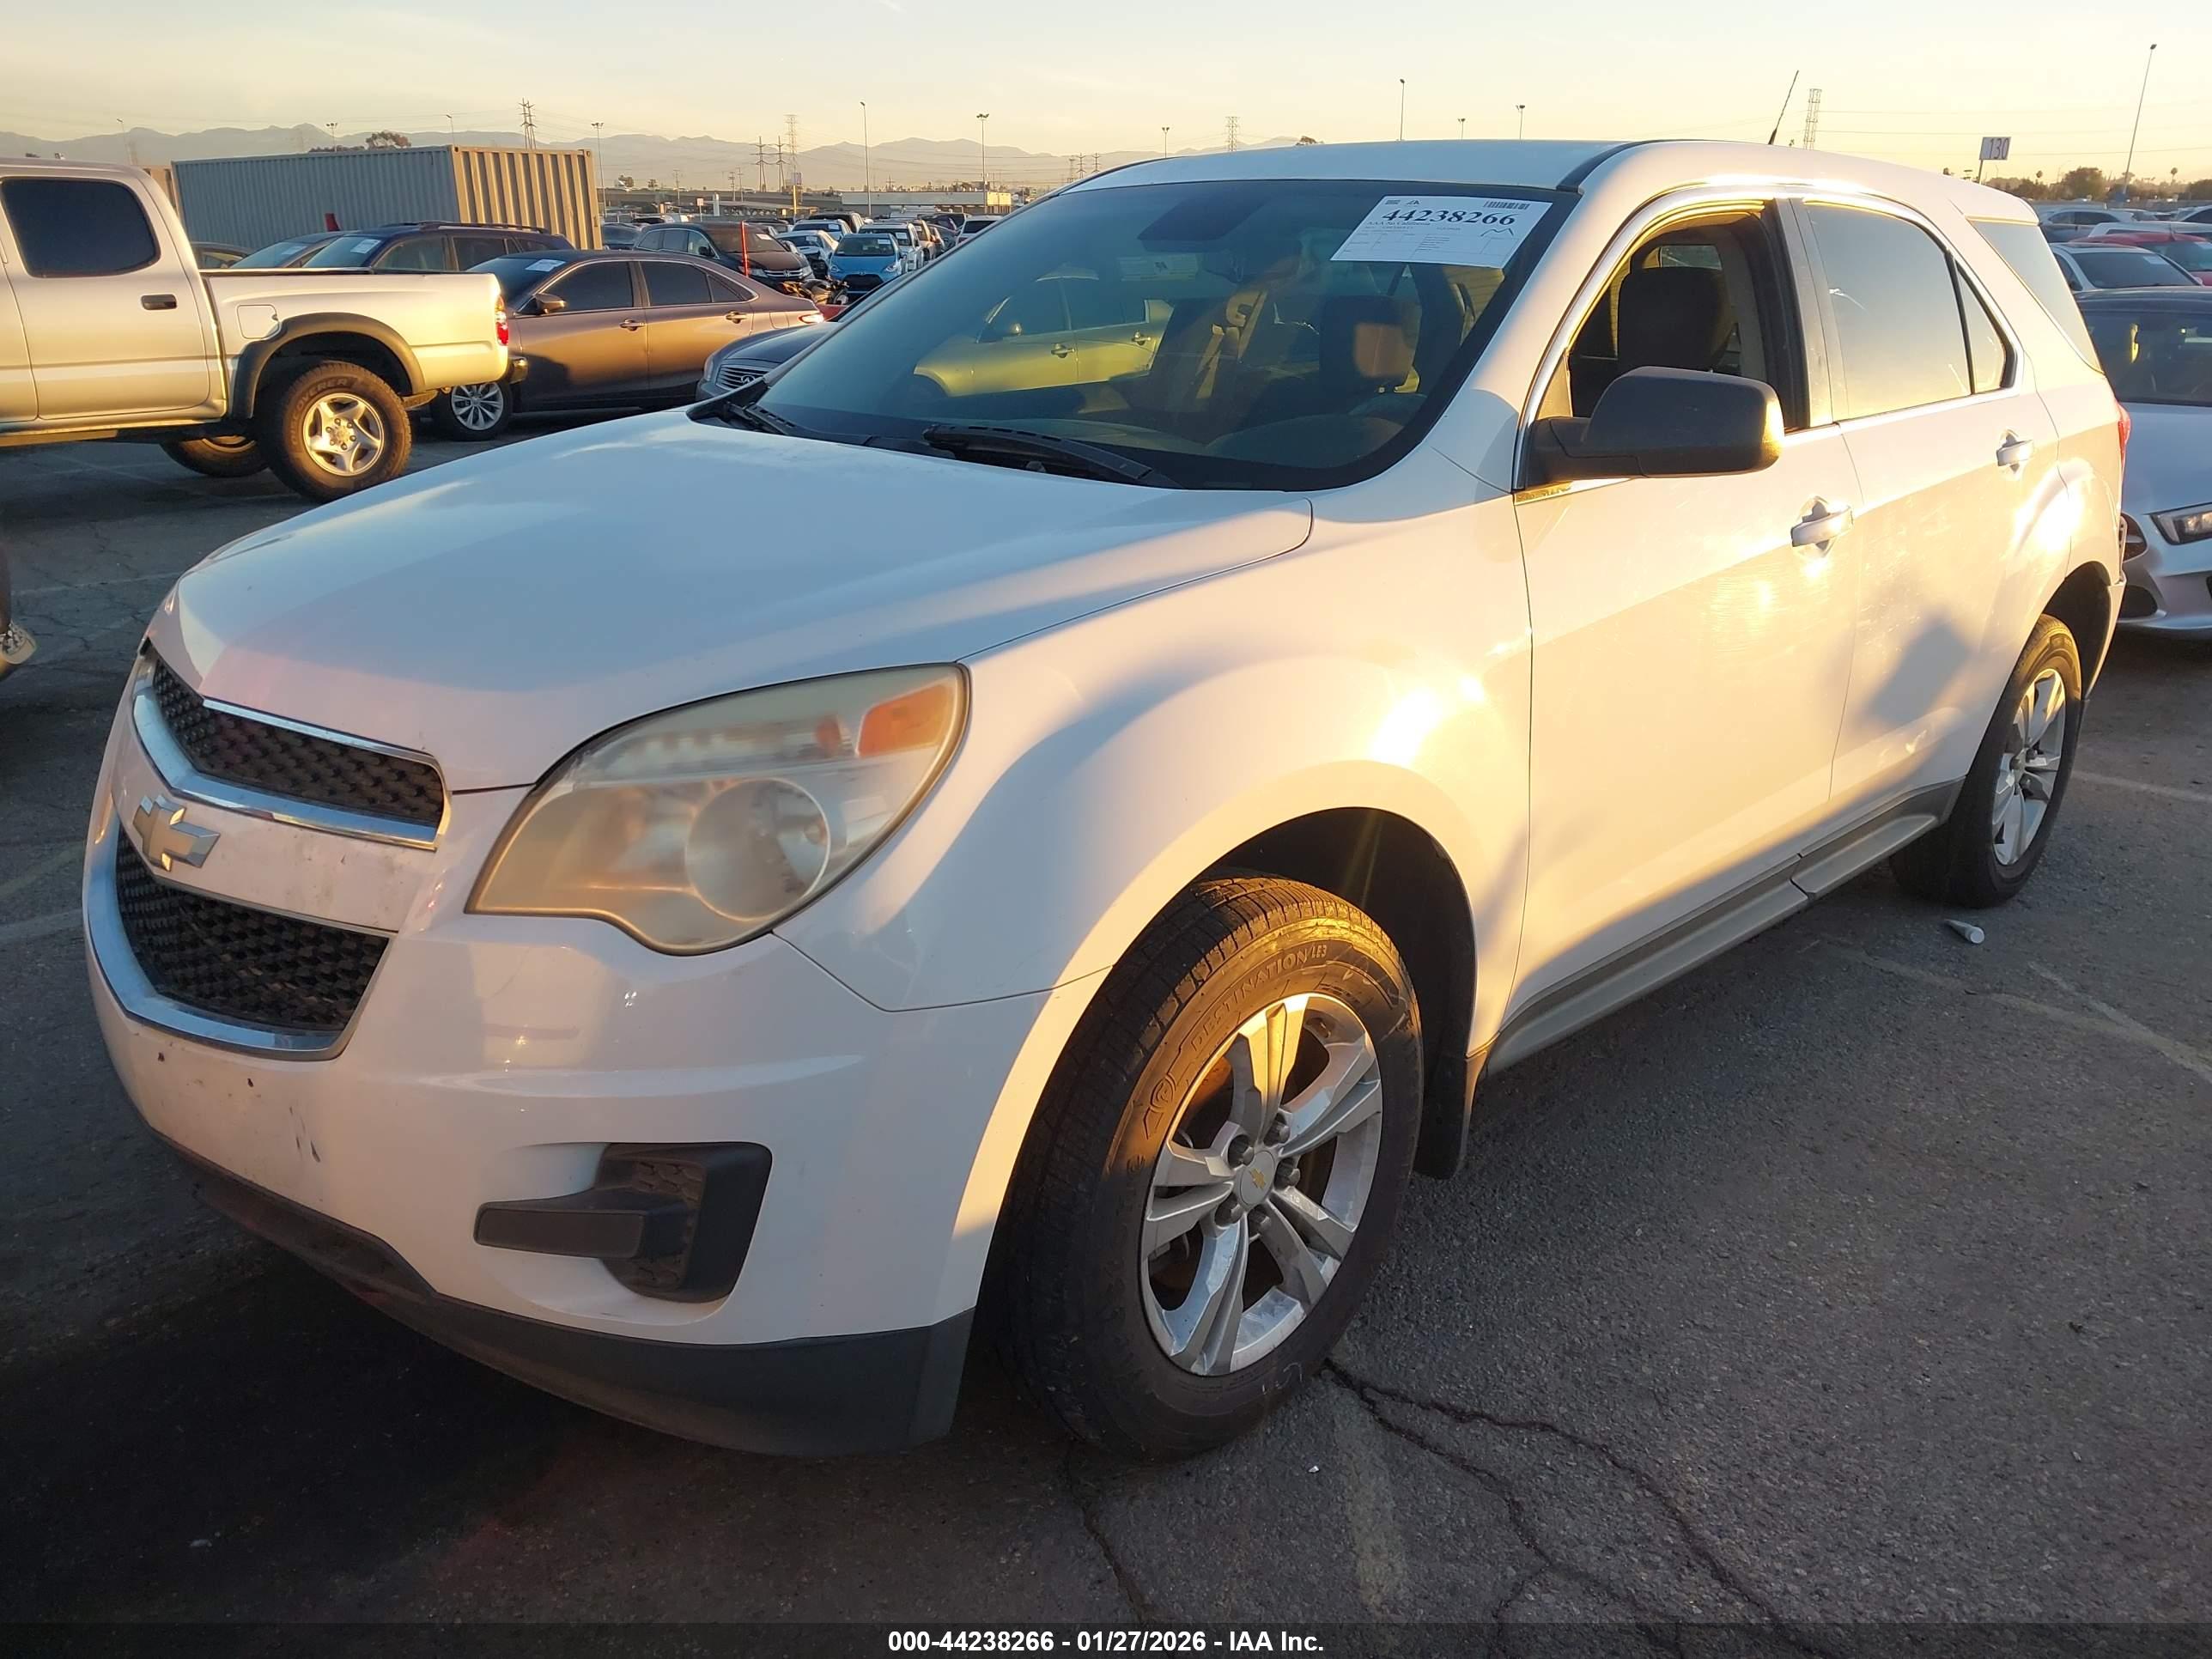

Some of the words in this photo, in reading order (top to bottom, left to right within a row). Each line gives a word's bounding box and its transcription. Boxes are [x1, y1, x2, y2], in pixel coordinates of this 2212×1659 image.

[1989, 137, 2009, 160] 130
[1382, 209, 1518, 226] 44238266
[1190, 950, 1310, 1052] DESTINATION
